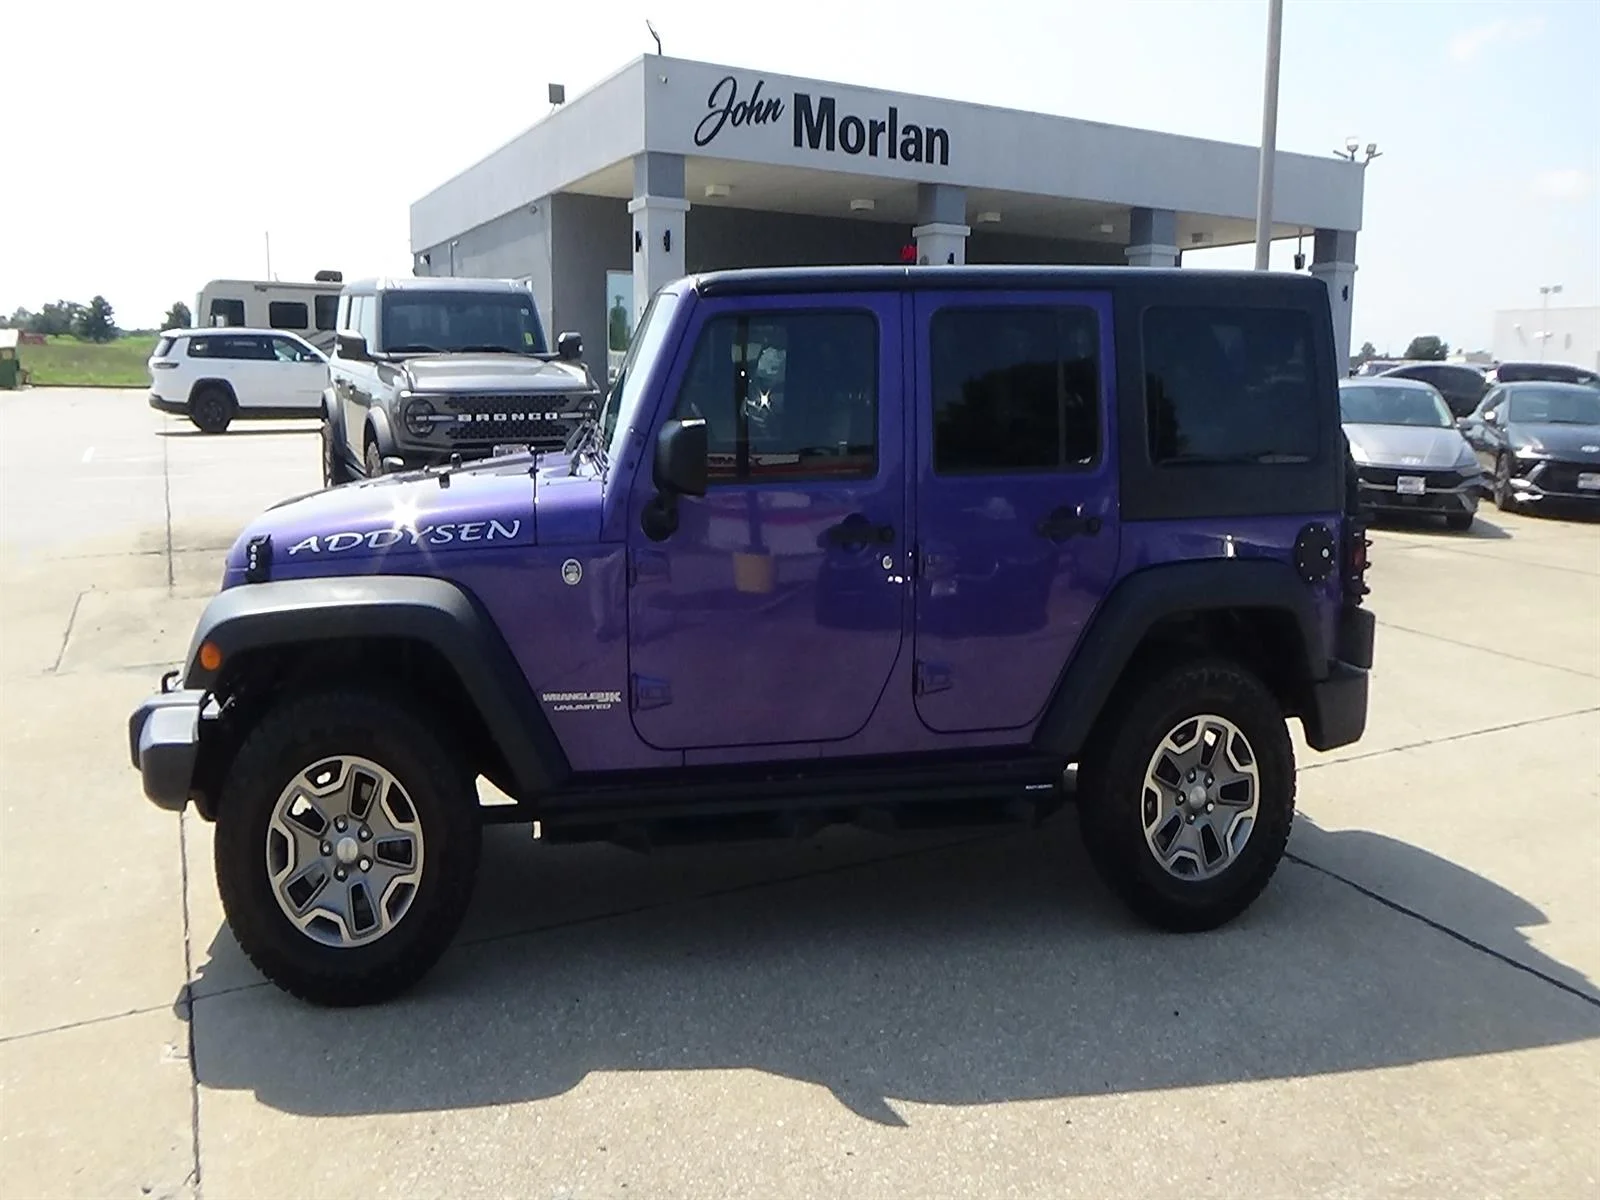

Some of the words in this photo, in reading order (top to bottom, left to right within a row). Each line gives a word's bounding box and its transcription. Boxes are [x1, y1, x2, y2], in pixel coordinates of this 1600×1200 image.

[694, 76, 785, 147] John
[793, 93, 950, 166] Morlan
[457, 411, 558, 423] BRONCO
[288, 519, 521, 556] ADDYSEN
[553, 703, 612, 712] UNLIMITED
